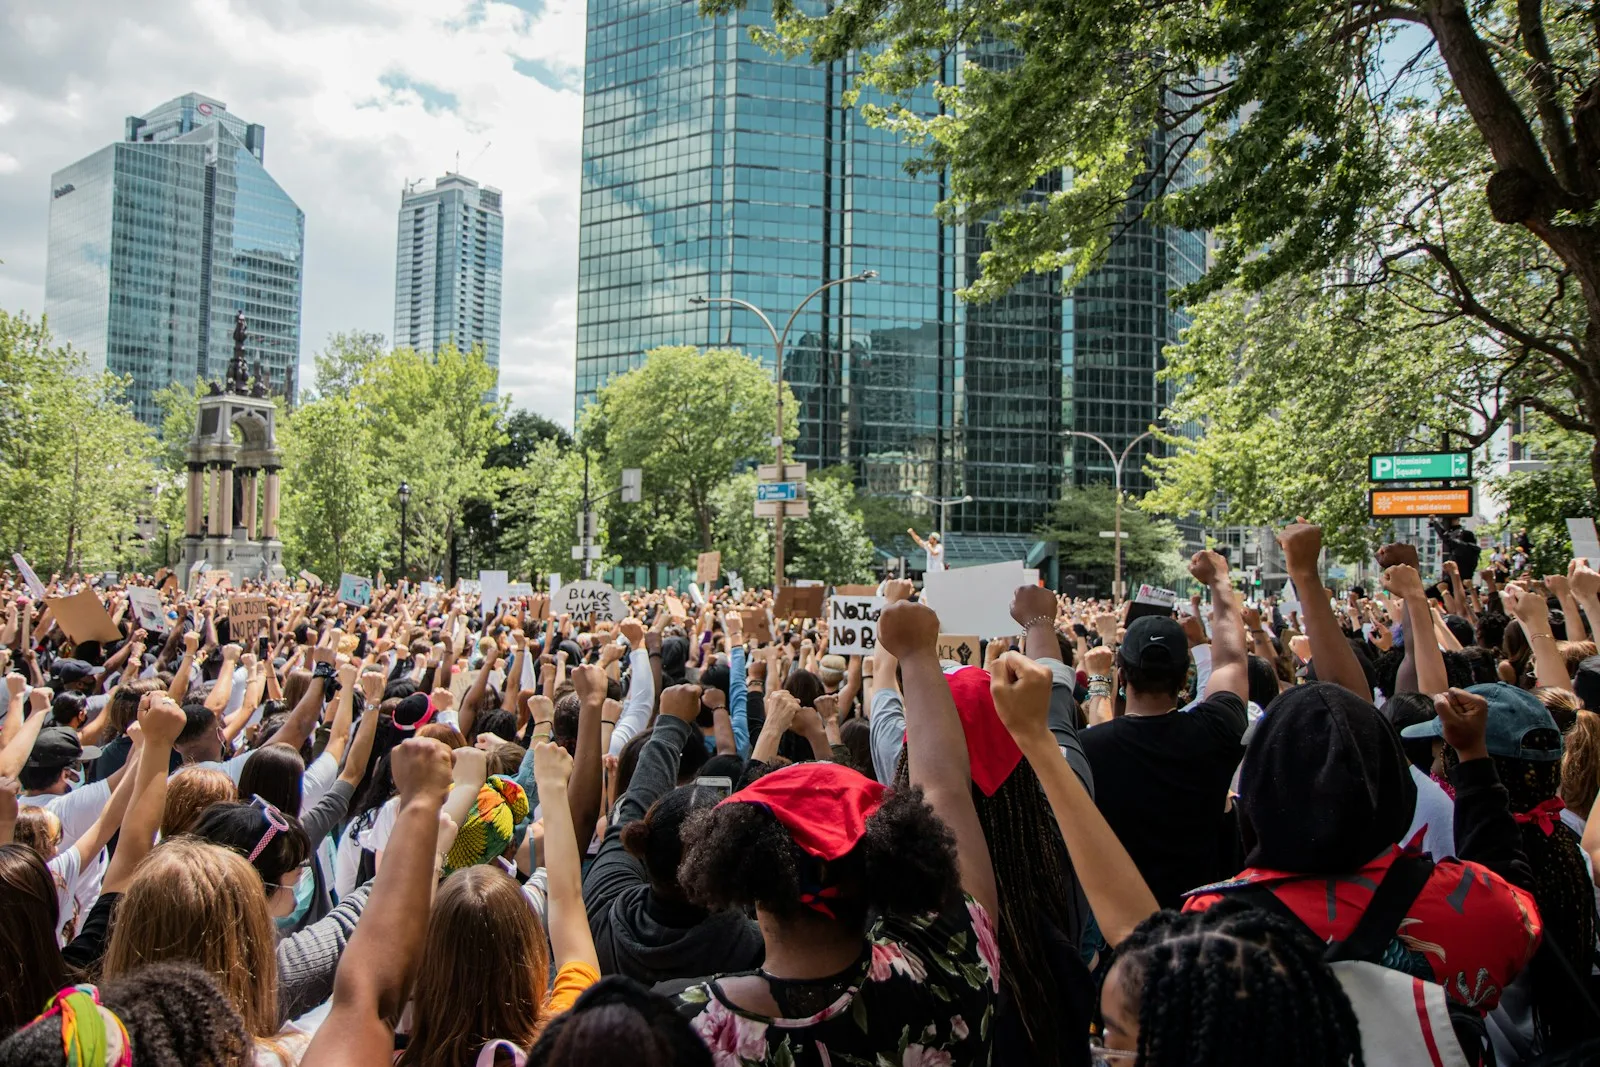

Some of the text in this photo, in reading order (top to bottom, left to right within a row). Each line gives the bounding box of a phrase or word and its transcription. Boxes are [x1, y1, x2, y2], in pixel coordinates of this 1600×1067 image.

[1396, 457, 1432, 465] Dominion
[1396, 468, 1422, 476] Square
[569, 588, 611, 602] BLACK
[566, 601, 610, 612] LIVES
